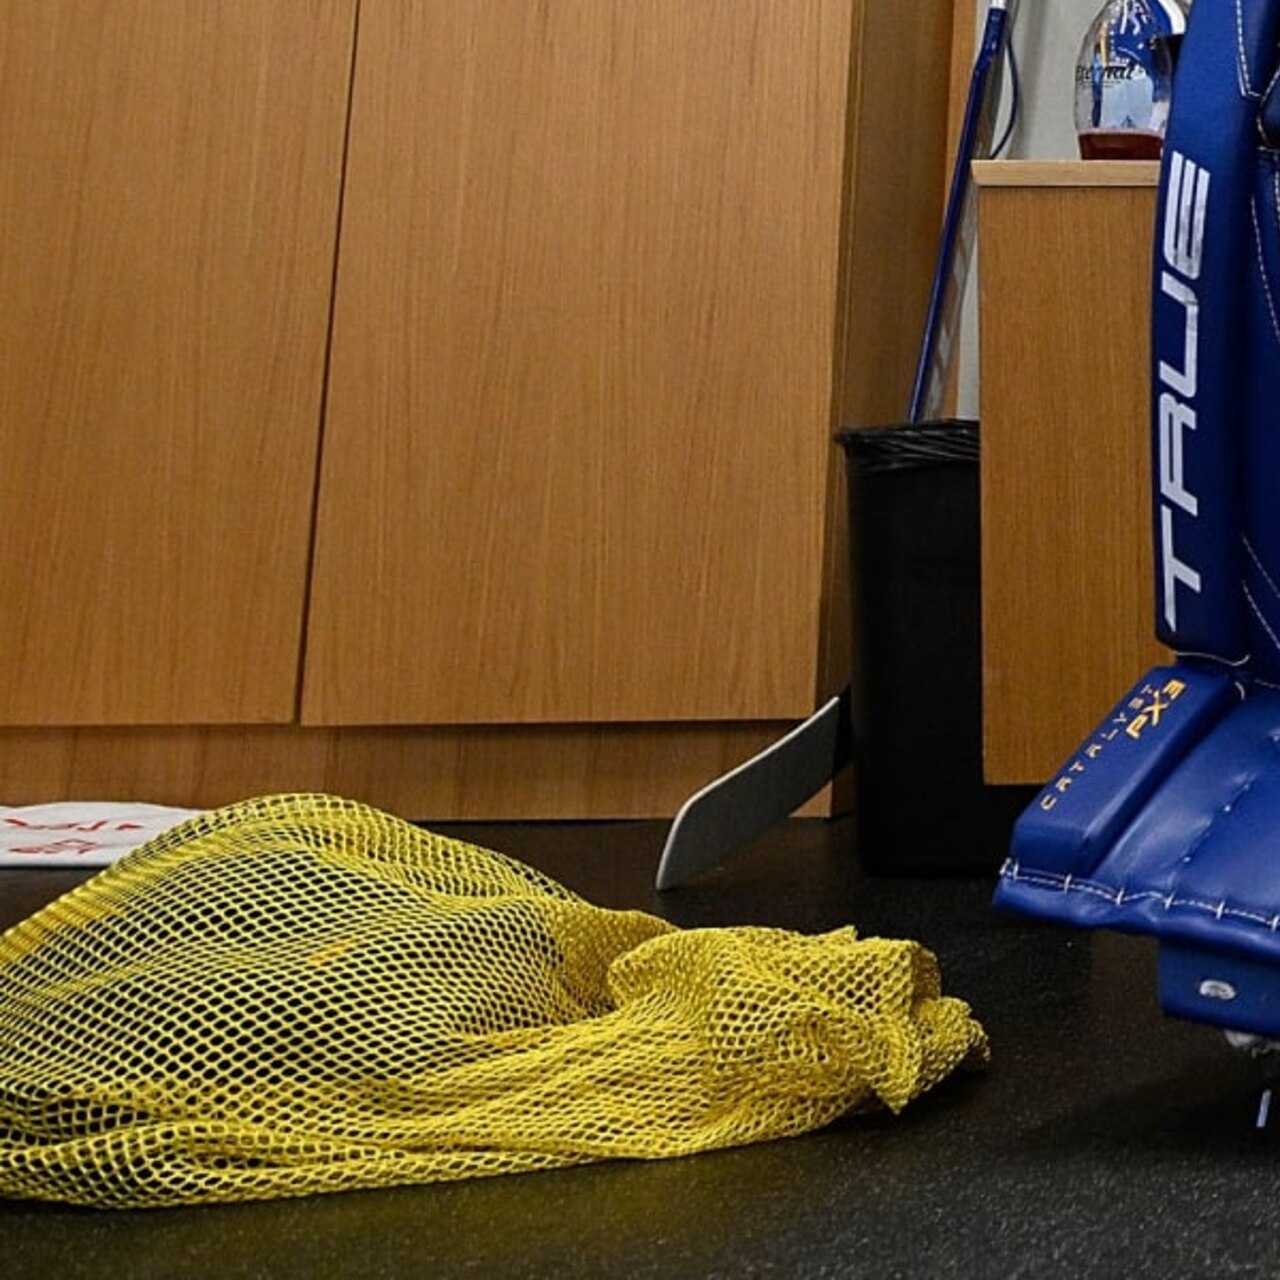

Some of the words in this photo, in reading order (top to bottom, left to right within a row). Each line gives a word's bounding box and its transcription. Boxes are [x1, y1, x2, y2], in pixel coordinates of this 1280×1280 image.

[1159, 150, 1211, 633] TRUE
[1040, 683, 1153, 810] CATALYST
[1125, 679, 1187, 740] PX3
